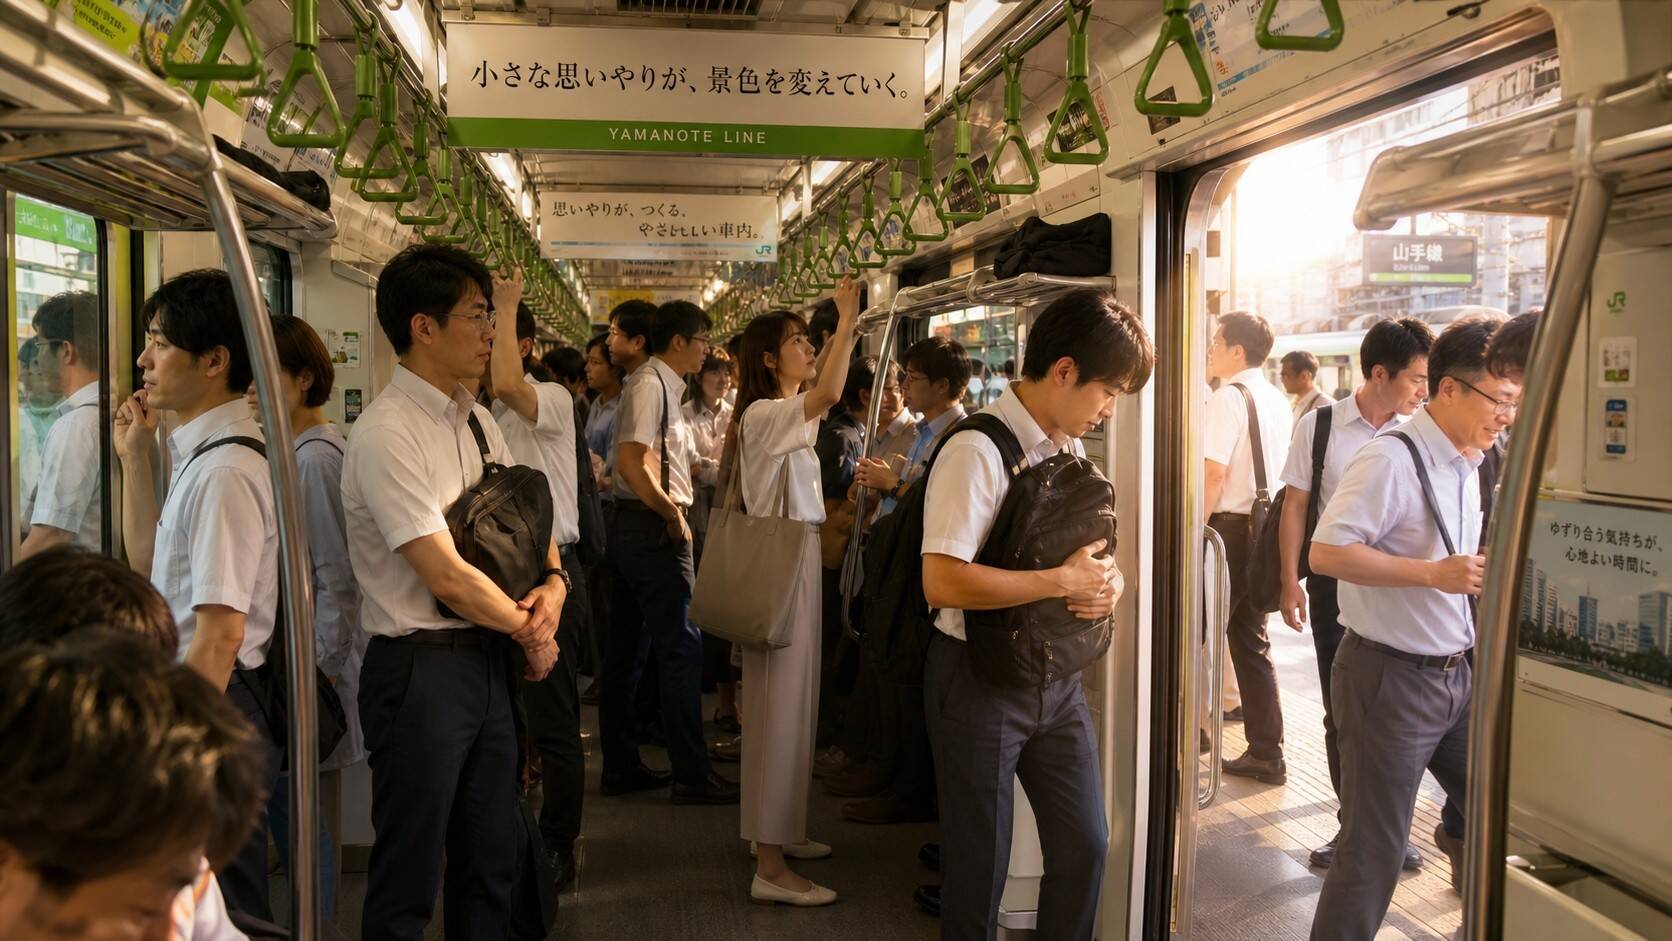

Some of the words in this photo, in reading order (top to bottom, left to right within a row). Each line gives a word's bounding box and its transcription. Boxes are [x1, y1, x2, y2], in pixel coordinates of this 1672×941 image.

[471, 60, 909, 99] 小さな思いやりが、景色を変えていく。
[608, 127, 713, 145] YAMANOTE
[724, 131, 767, 145] LINE
[755, 245, 772, 255] JR
[1607, 291, 1626, 308] JR
[1550, 522, 1663, 552] ゆずり合う気持ちが、
[1565, 546, 1658, 576] 心地よい時間に。
